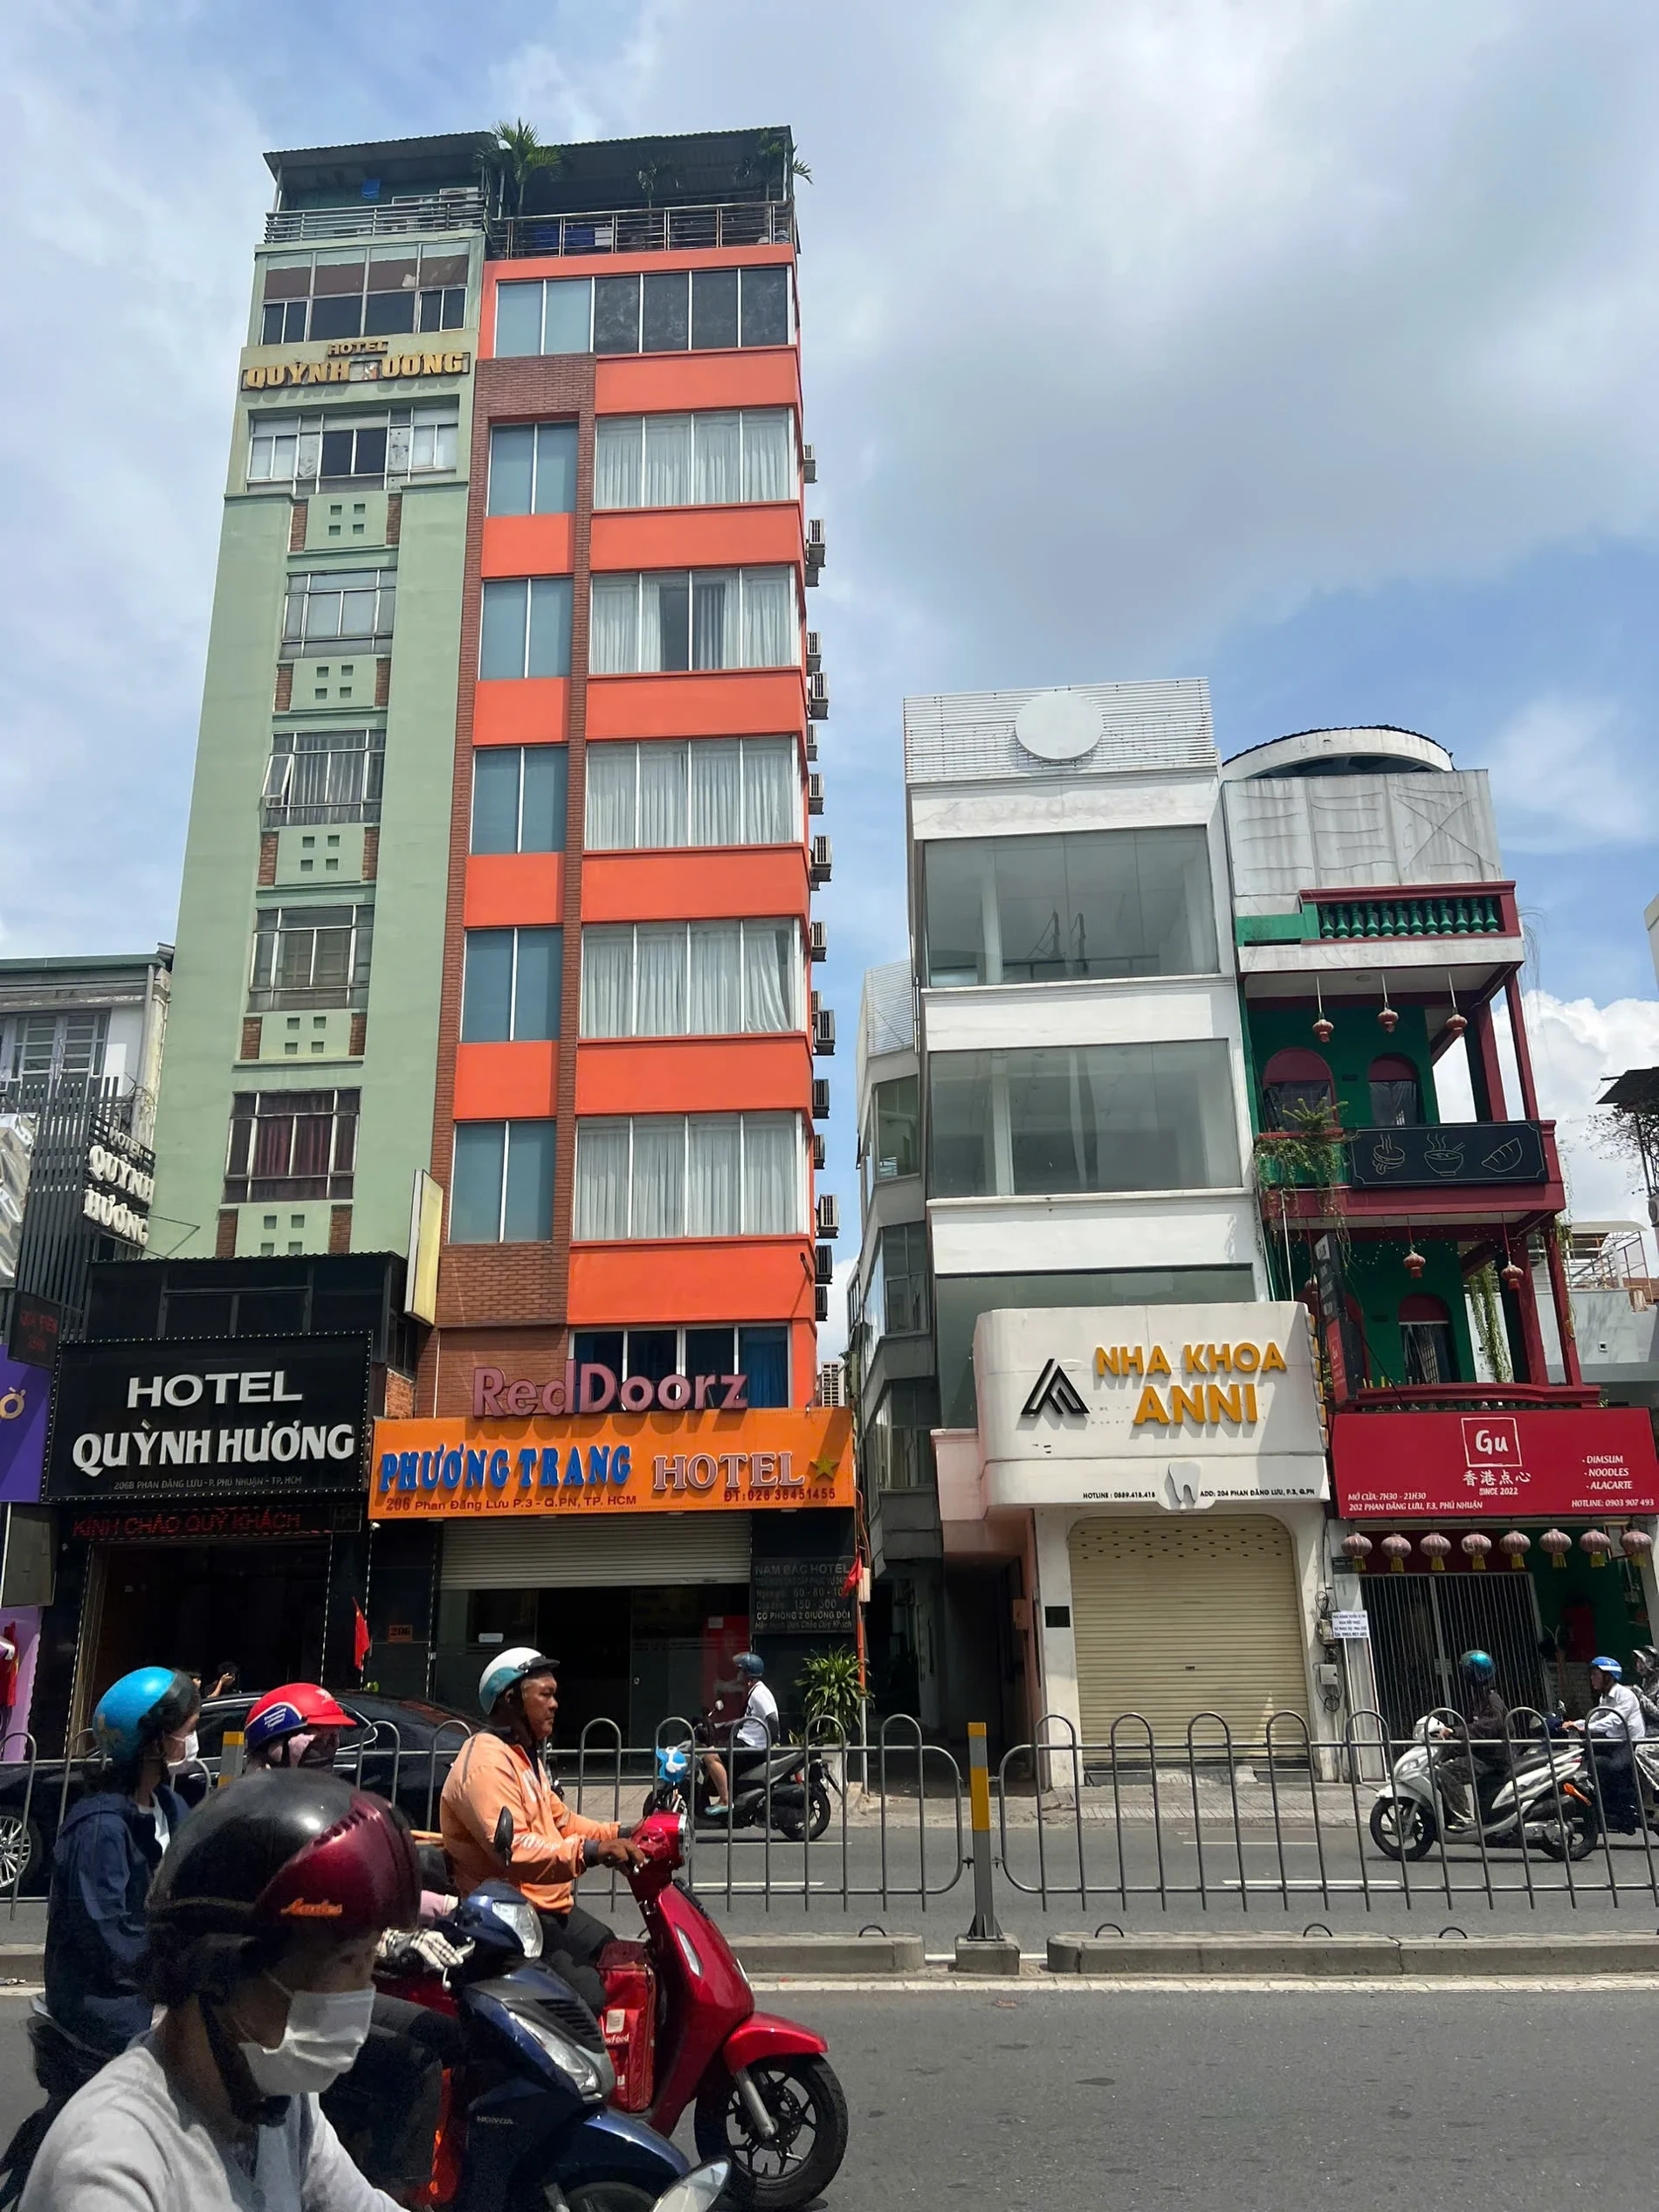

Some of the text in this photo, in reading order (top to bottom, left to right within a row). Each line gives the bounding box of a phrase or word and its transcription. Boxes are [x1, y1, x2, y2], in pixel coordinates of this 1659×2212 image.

[328, 340, 388, 355] HOTEL
[109, 1126, 144, 1156] HOTEL
[83, 1189, 149, 1246] HƯƠNG
[1095, 1341, 1287, 1376] NHA KHOA
[127, 1370, 303, 1409] HOTEL
[472, 1358, 748, 1418] RedDoorz
[1132, 1382, 1258, 1425] ANNI
[72, 1419, 355, 1478] QUỲNH HƯƠNG
[1476, 1430, 1509, 1455] Gu
[379, 1443, 806, 1492] PHƯƠNG TRANG HOTEL
[1587, 1455, 1623, 1464] DIMSUM
[1463, 1469, 1532, 1486] 香港点心
[1588, 1468, 1629, 1477] NOODLES
[136, 1479, 159, 1490] PHAN
[774, 1486, 836, 1499] 38451455
[1500, 1486, 1518, 1495] 2022
[1590, 1481, 1633, 1490] ALACARTE
[386, 1496, 410, 1511] 206
[415, 1500, 445, 1511] Phan
[485, 1497, 509, 1508] Lưu
[513, 1496, 533, 1508] P.3
[584, 1496, 604, 1506] TP.
[608, 1494, 637, 1506] HCM
[1403, 1492, 1426, 1500] 21H30
[810, 1563, 850, 1575] HOTEL
[477, 2115, 513, 2125] HONDA
